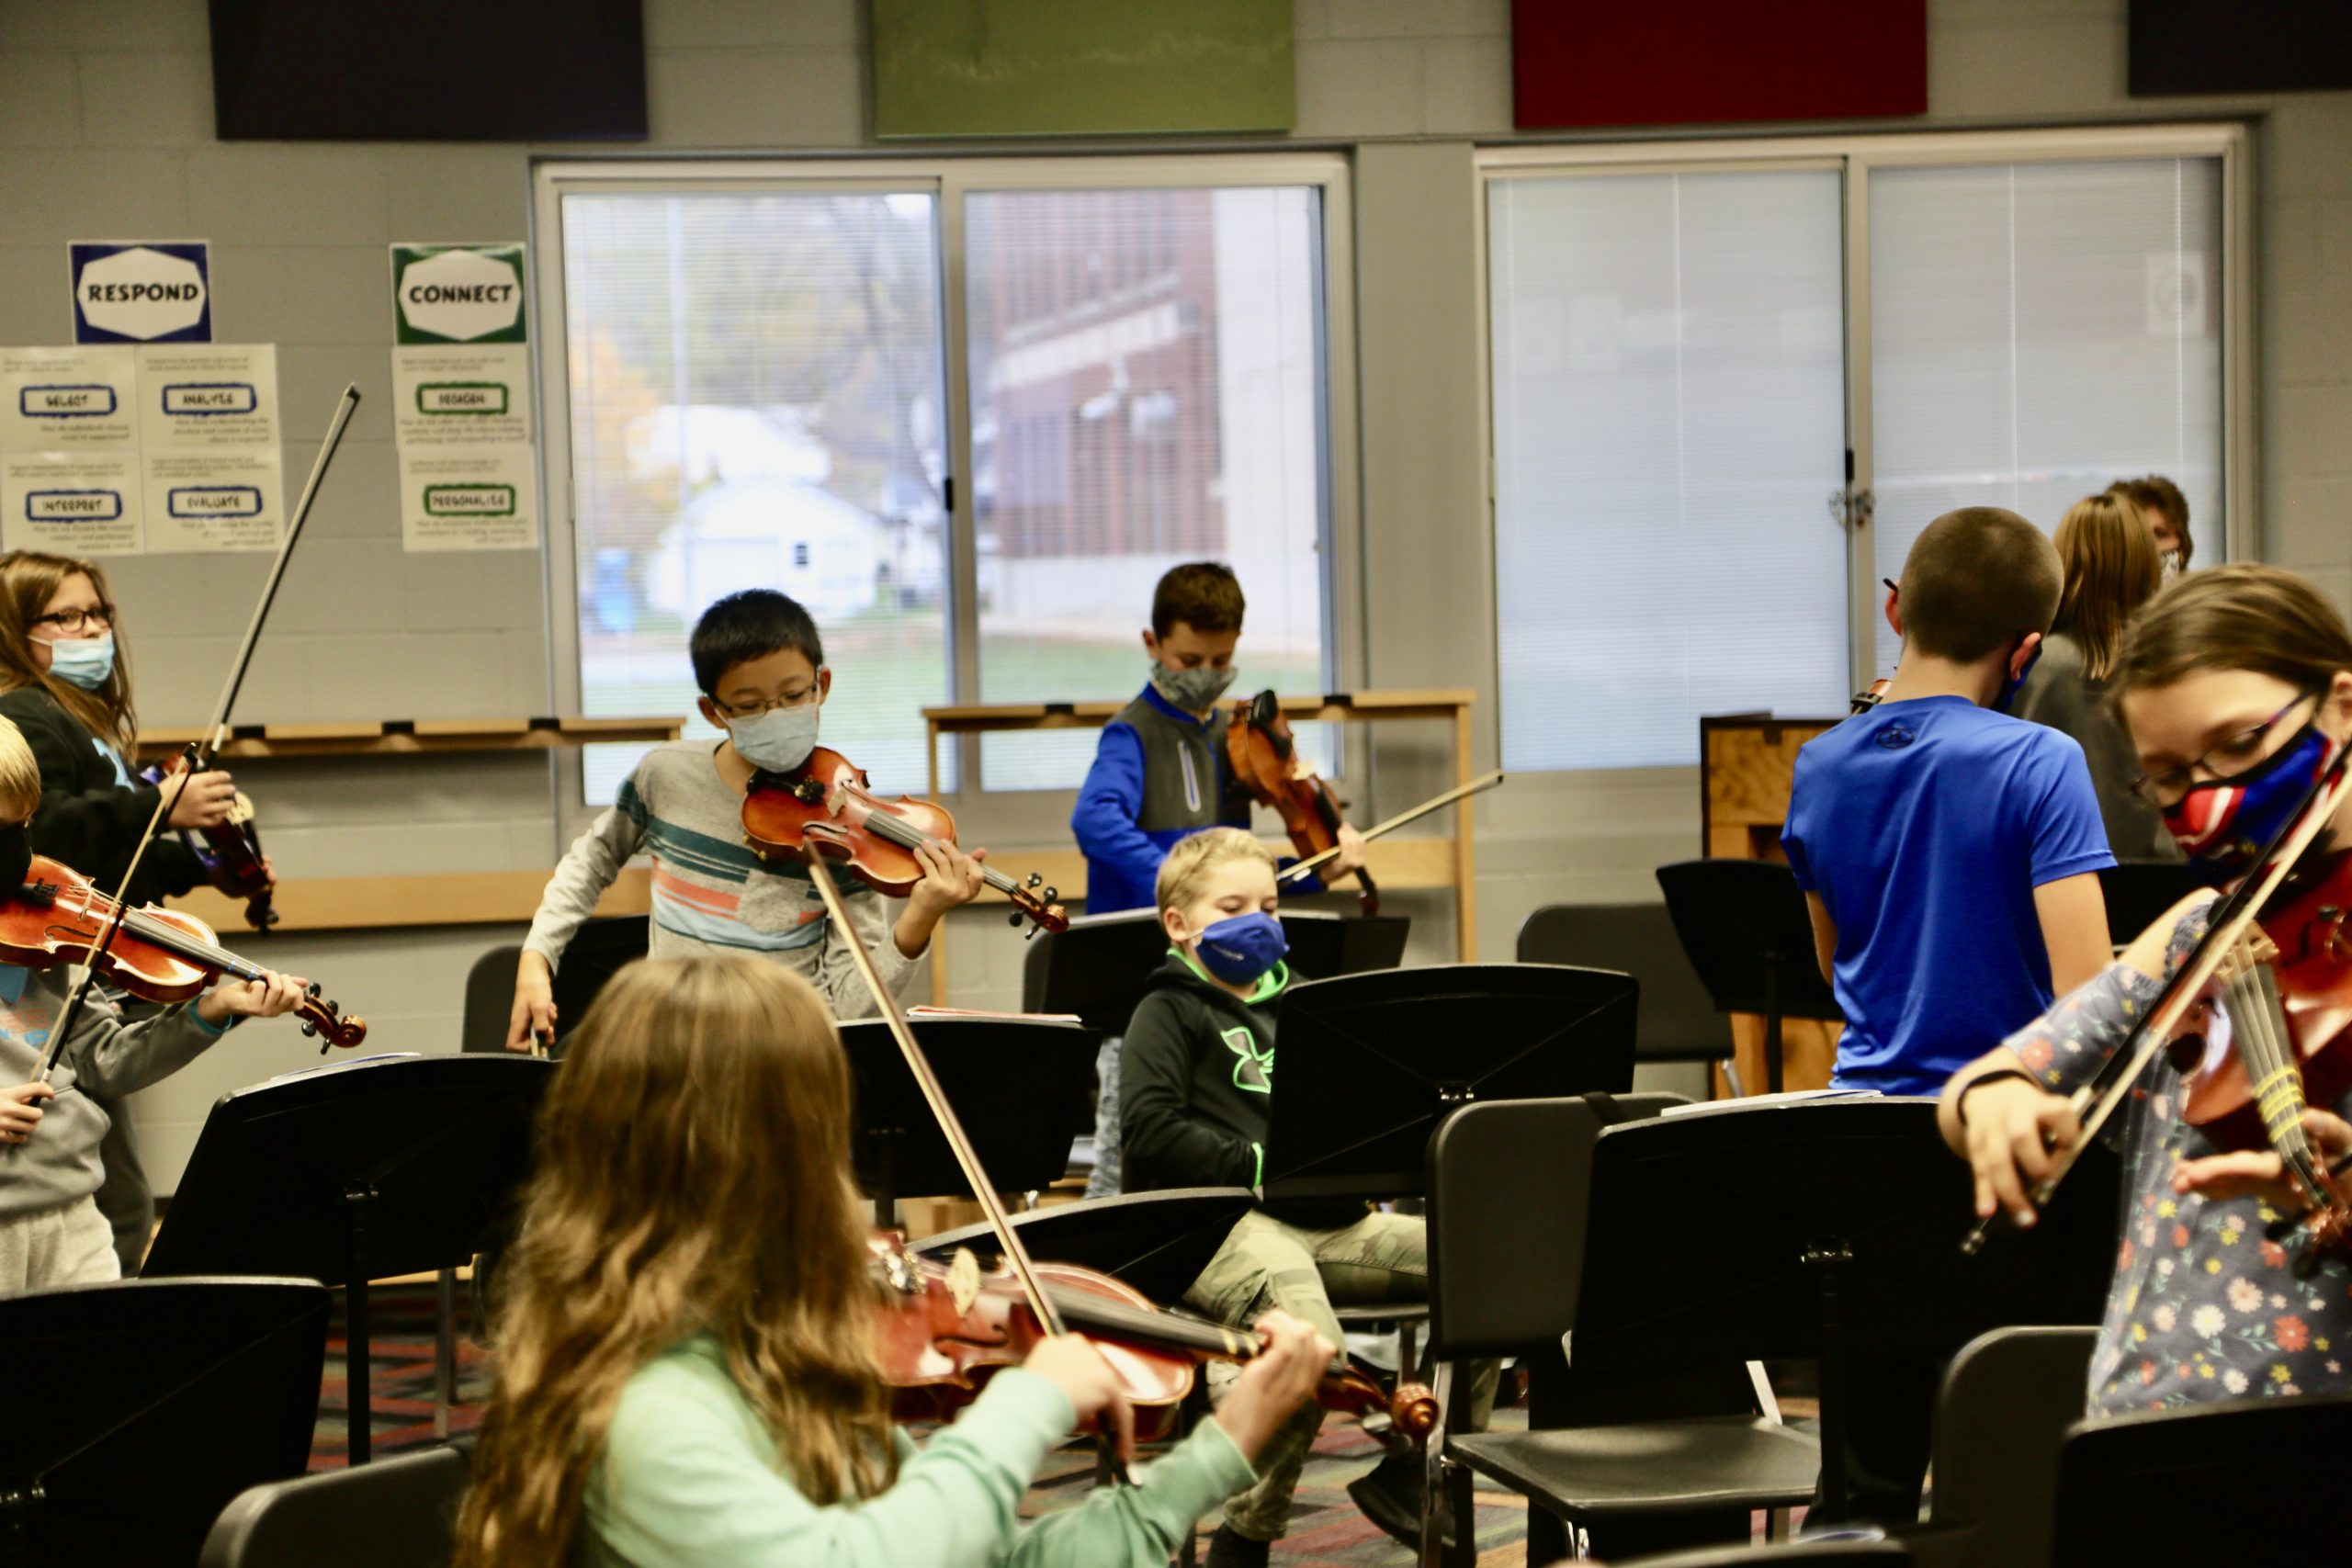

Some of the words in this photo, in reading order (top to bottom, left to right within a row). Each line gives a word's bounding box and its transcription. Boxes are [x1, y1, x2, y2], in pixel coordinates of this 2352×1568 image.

[87, 283, 198, 302] RESPOND
[409, 285, 513, 304] CONNECT
[46, 393, 88, 408] SELECT
[42, 499, 102, 513] INTERPRET
[187, 494, 240, 509] EVALUATE
